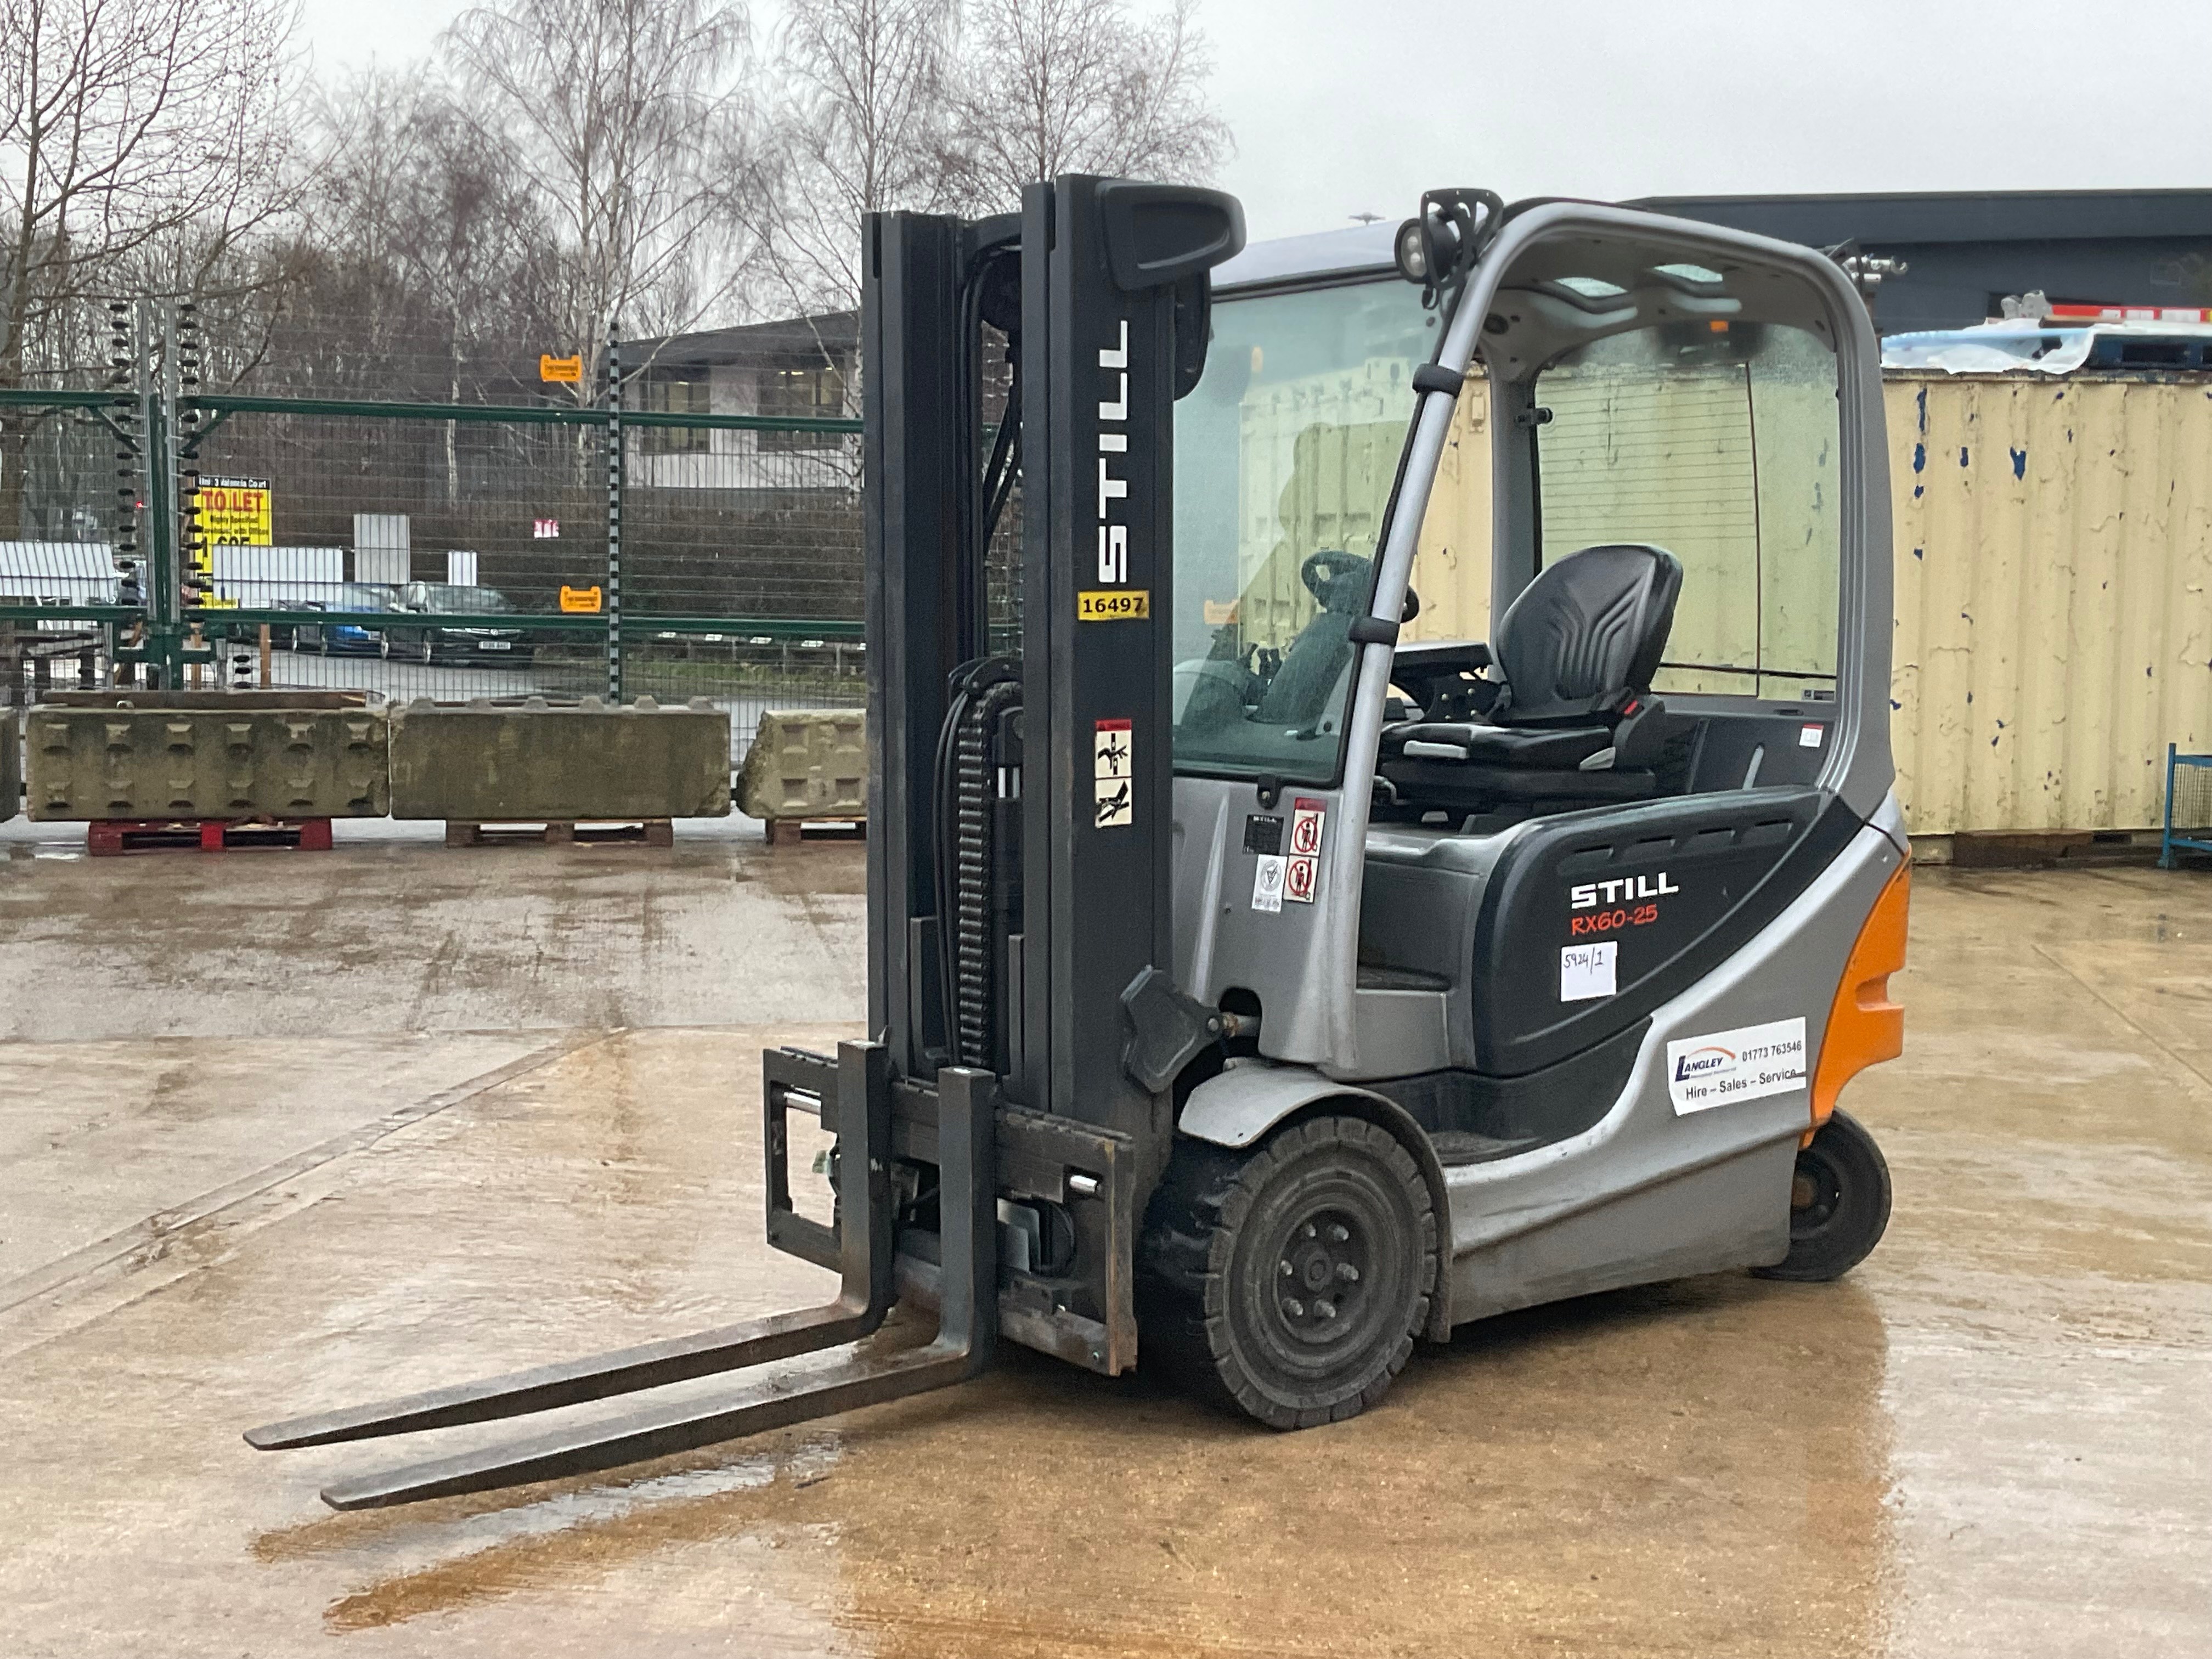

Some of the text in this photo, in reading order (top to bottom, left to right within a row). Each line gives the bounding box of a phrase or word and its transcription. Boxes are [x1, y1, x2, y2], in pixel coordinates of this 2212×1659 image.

[1099, 320, 1127, 583] STILL
[202, 490, 263, 513] TO LET
[1083, 597, 1144, 613] 16497
[1571, 872, 1679, 909] STILL
[1571, 904, 1658, 936] RX60-25
[1742, 1040, 1802, 1062] 01773 763546
[1675, 1055, 1723, 1082] LANGLEY
[1686, 1086, 1707, 1101] Hire
[1719, 1078, 1747, 1093] Sales
[1759, 1068, 1797, 1085] Service
